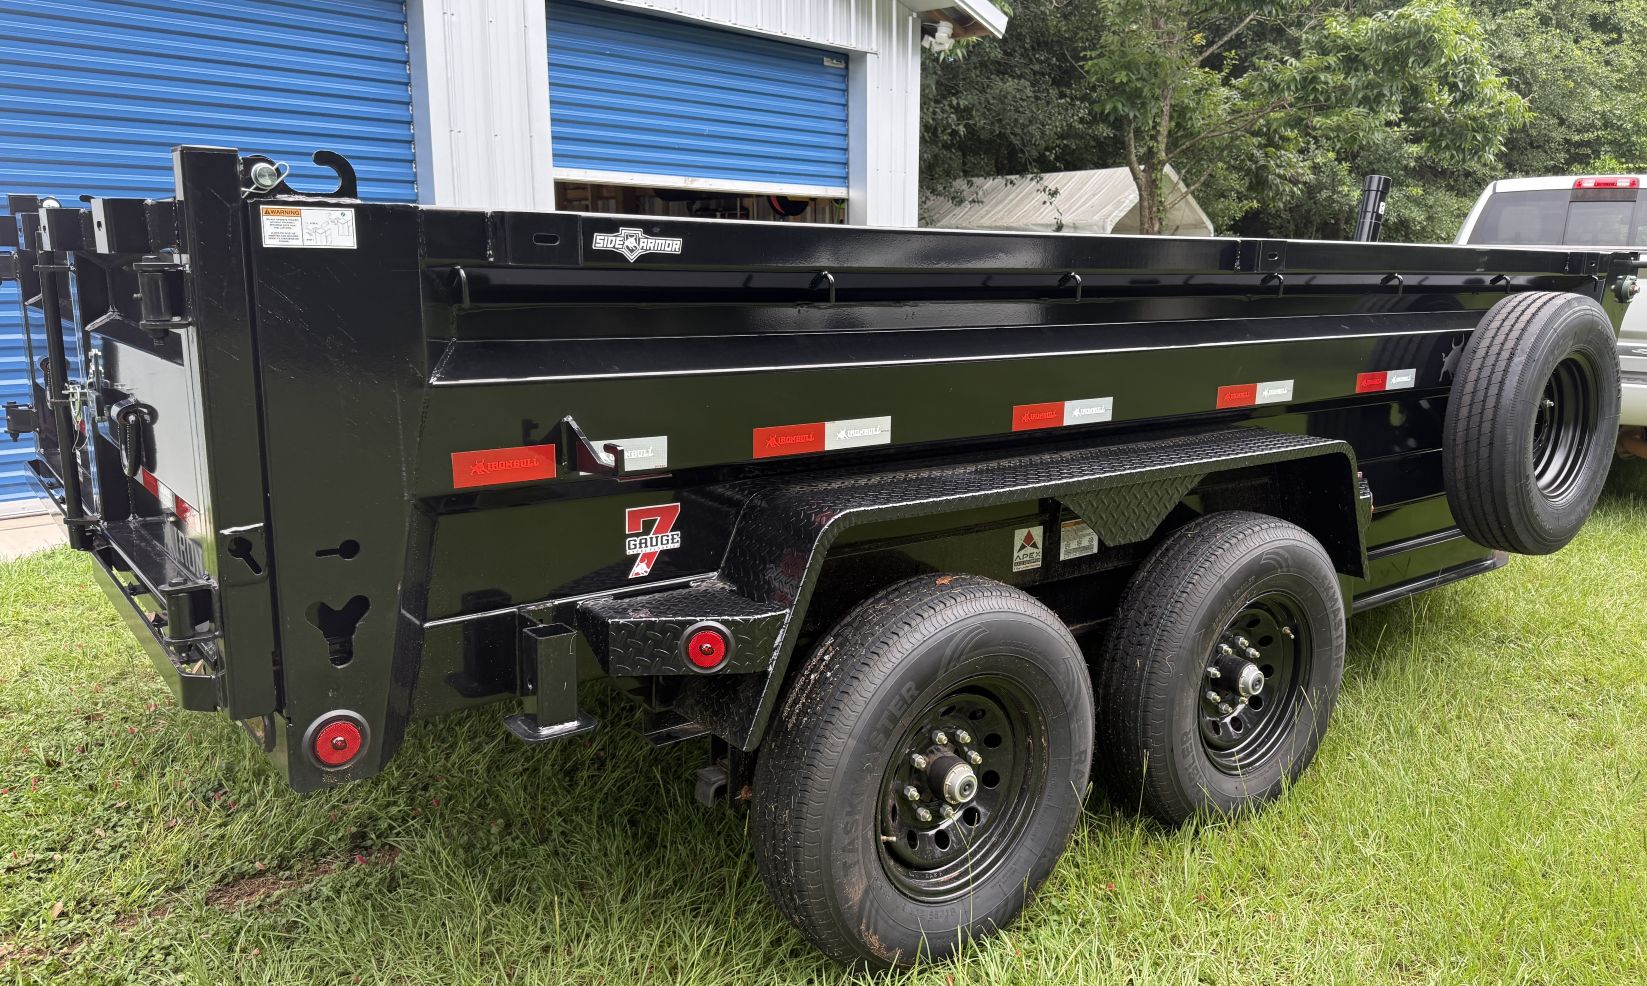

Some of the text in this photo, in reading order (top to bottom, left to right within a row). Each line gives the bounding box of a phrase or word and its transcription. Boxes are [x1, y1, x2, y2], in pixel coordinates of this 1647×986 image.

[595, 235, 680, 252] SIDE ARMOR
[778, 433, 815, 445] IRONBULL
[487, 457, 540, 471] IRONBULL
[626, 502, 680, 579] 7
[627, 533, 680, 551] GAUGE
[1014, 551, 1041, 562] APEX
